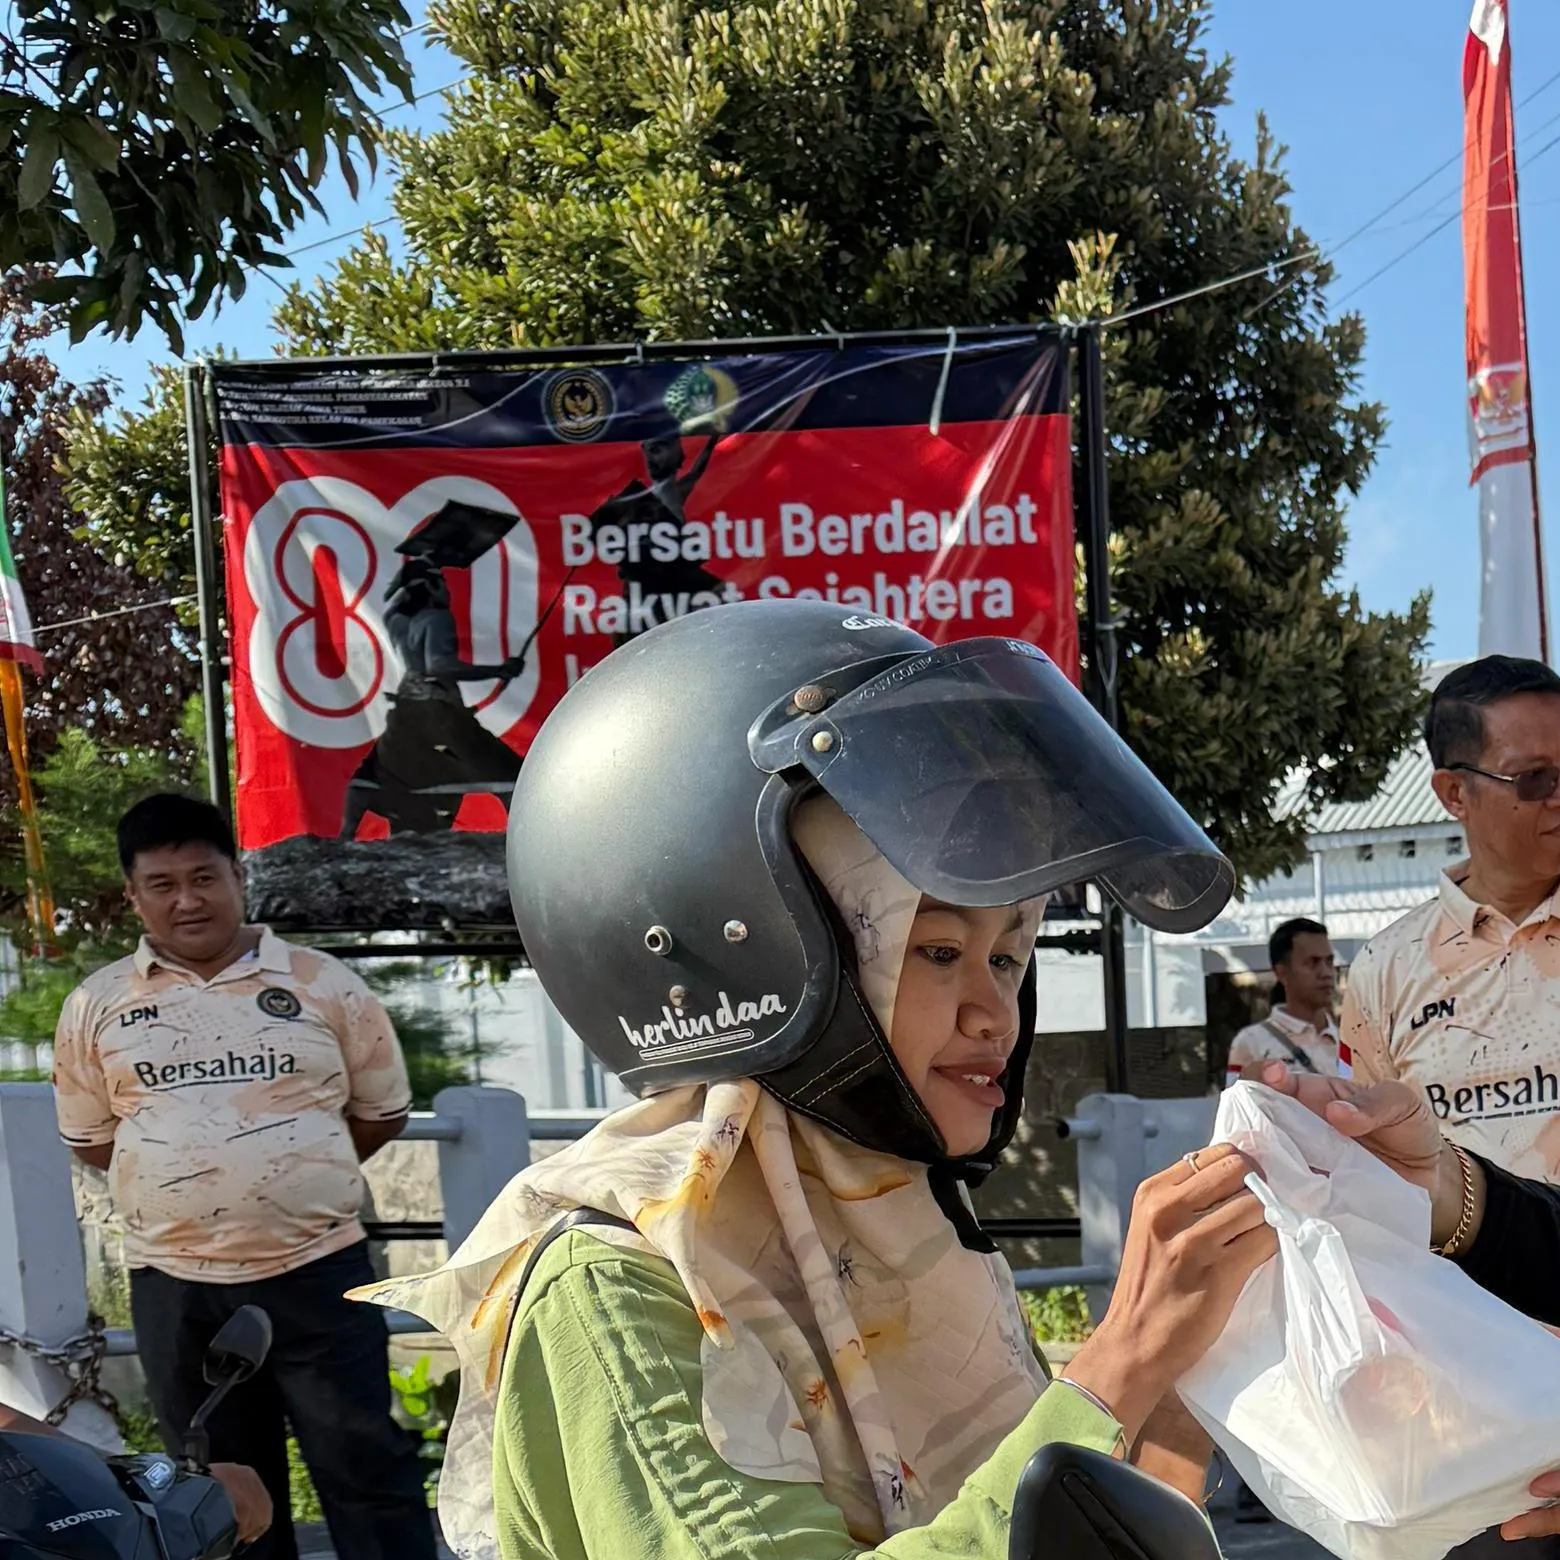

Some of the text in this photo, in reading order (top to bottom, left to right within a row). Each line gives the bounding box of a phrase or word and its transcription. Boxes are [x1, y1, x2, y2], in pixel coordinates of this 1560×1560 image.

[560, 493, 1038, 567] Bersatu Berdaulat
[243, 475, 540, 748] 80
[120, 1004, 158, 1028] LPN
[1410, 996, 1456, 1030] LPN
[134, 1047, 296, 1088] Bersahaja
[45, 1507, 122, 1533] HONDA
